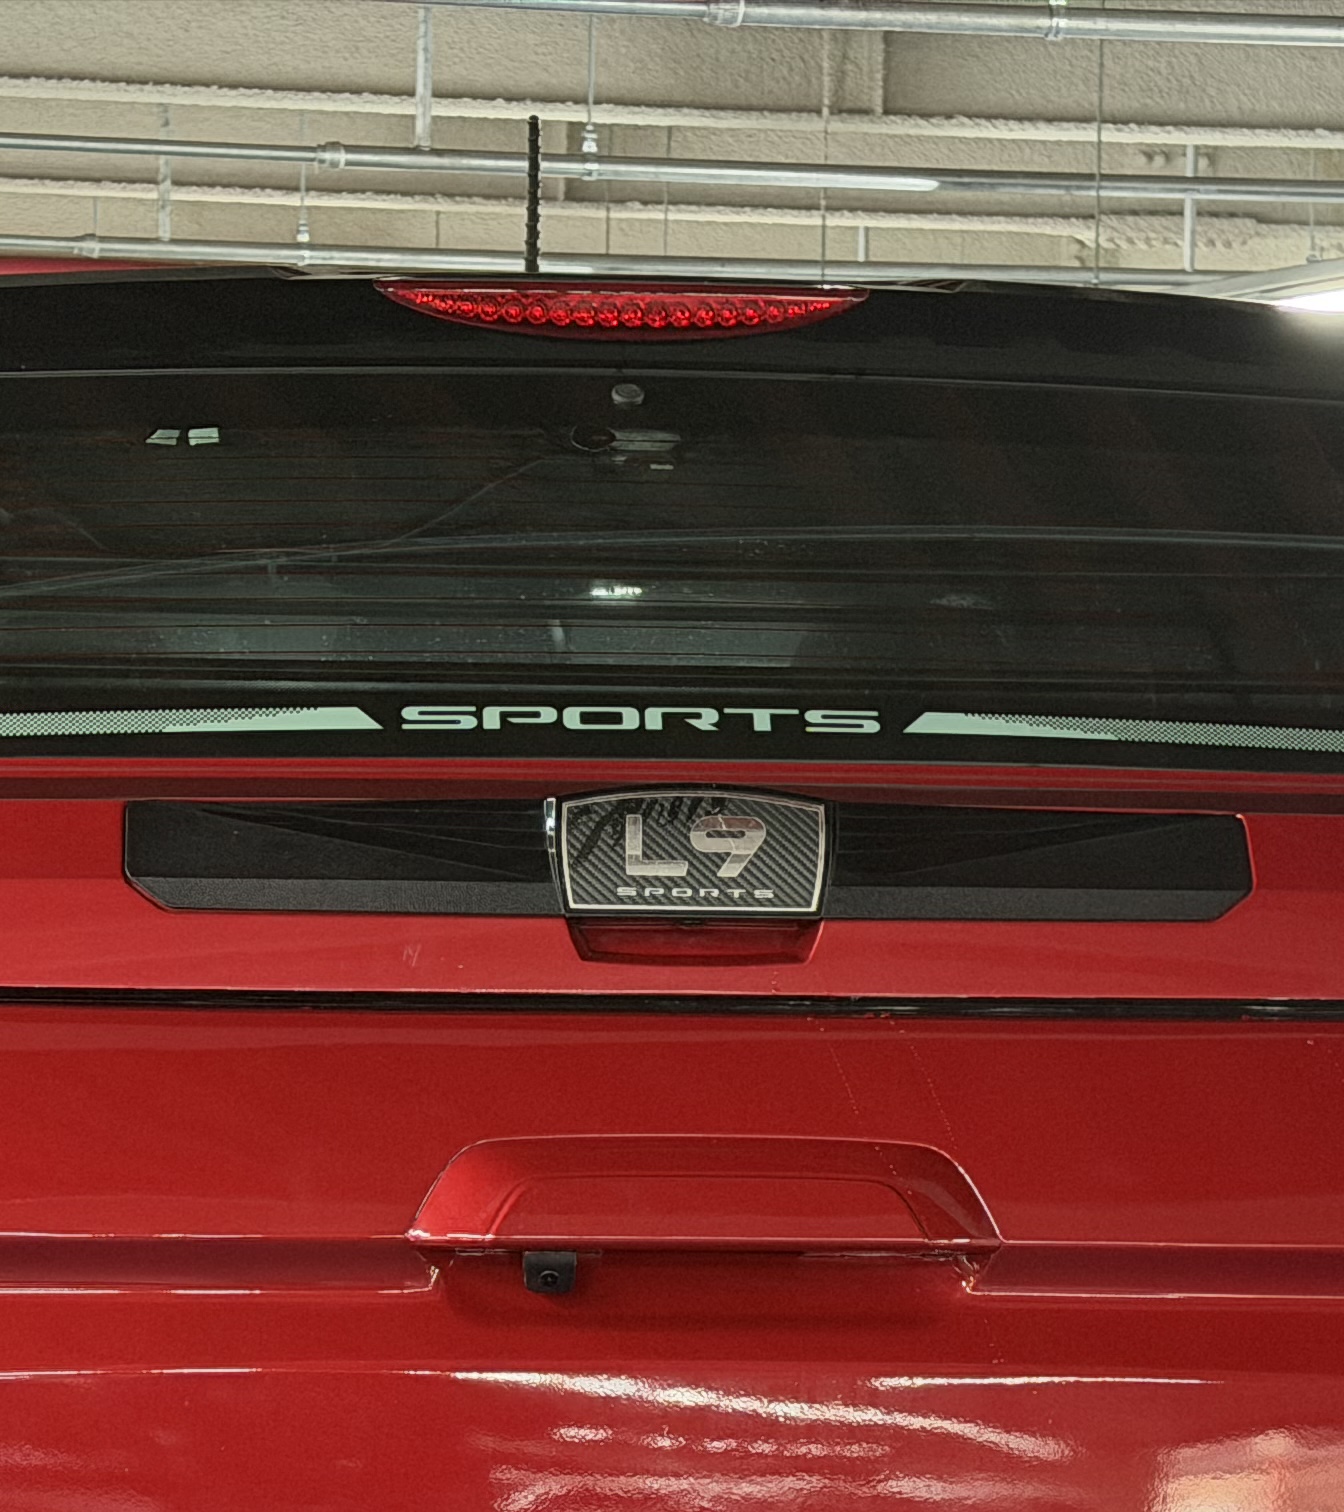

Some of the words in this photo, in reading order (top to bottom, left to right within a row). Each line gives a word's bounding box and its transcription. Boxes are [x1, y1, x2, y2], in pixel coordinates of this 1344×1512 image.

[400, 705, 881, 734] SPORTS
[625, 814, 767, 877] L9
[616, 886, 775, 899] SPORTS
